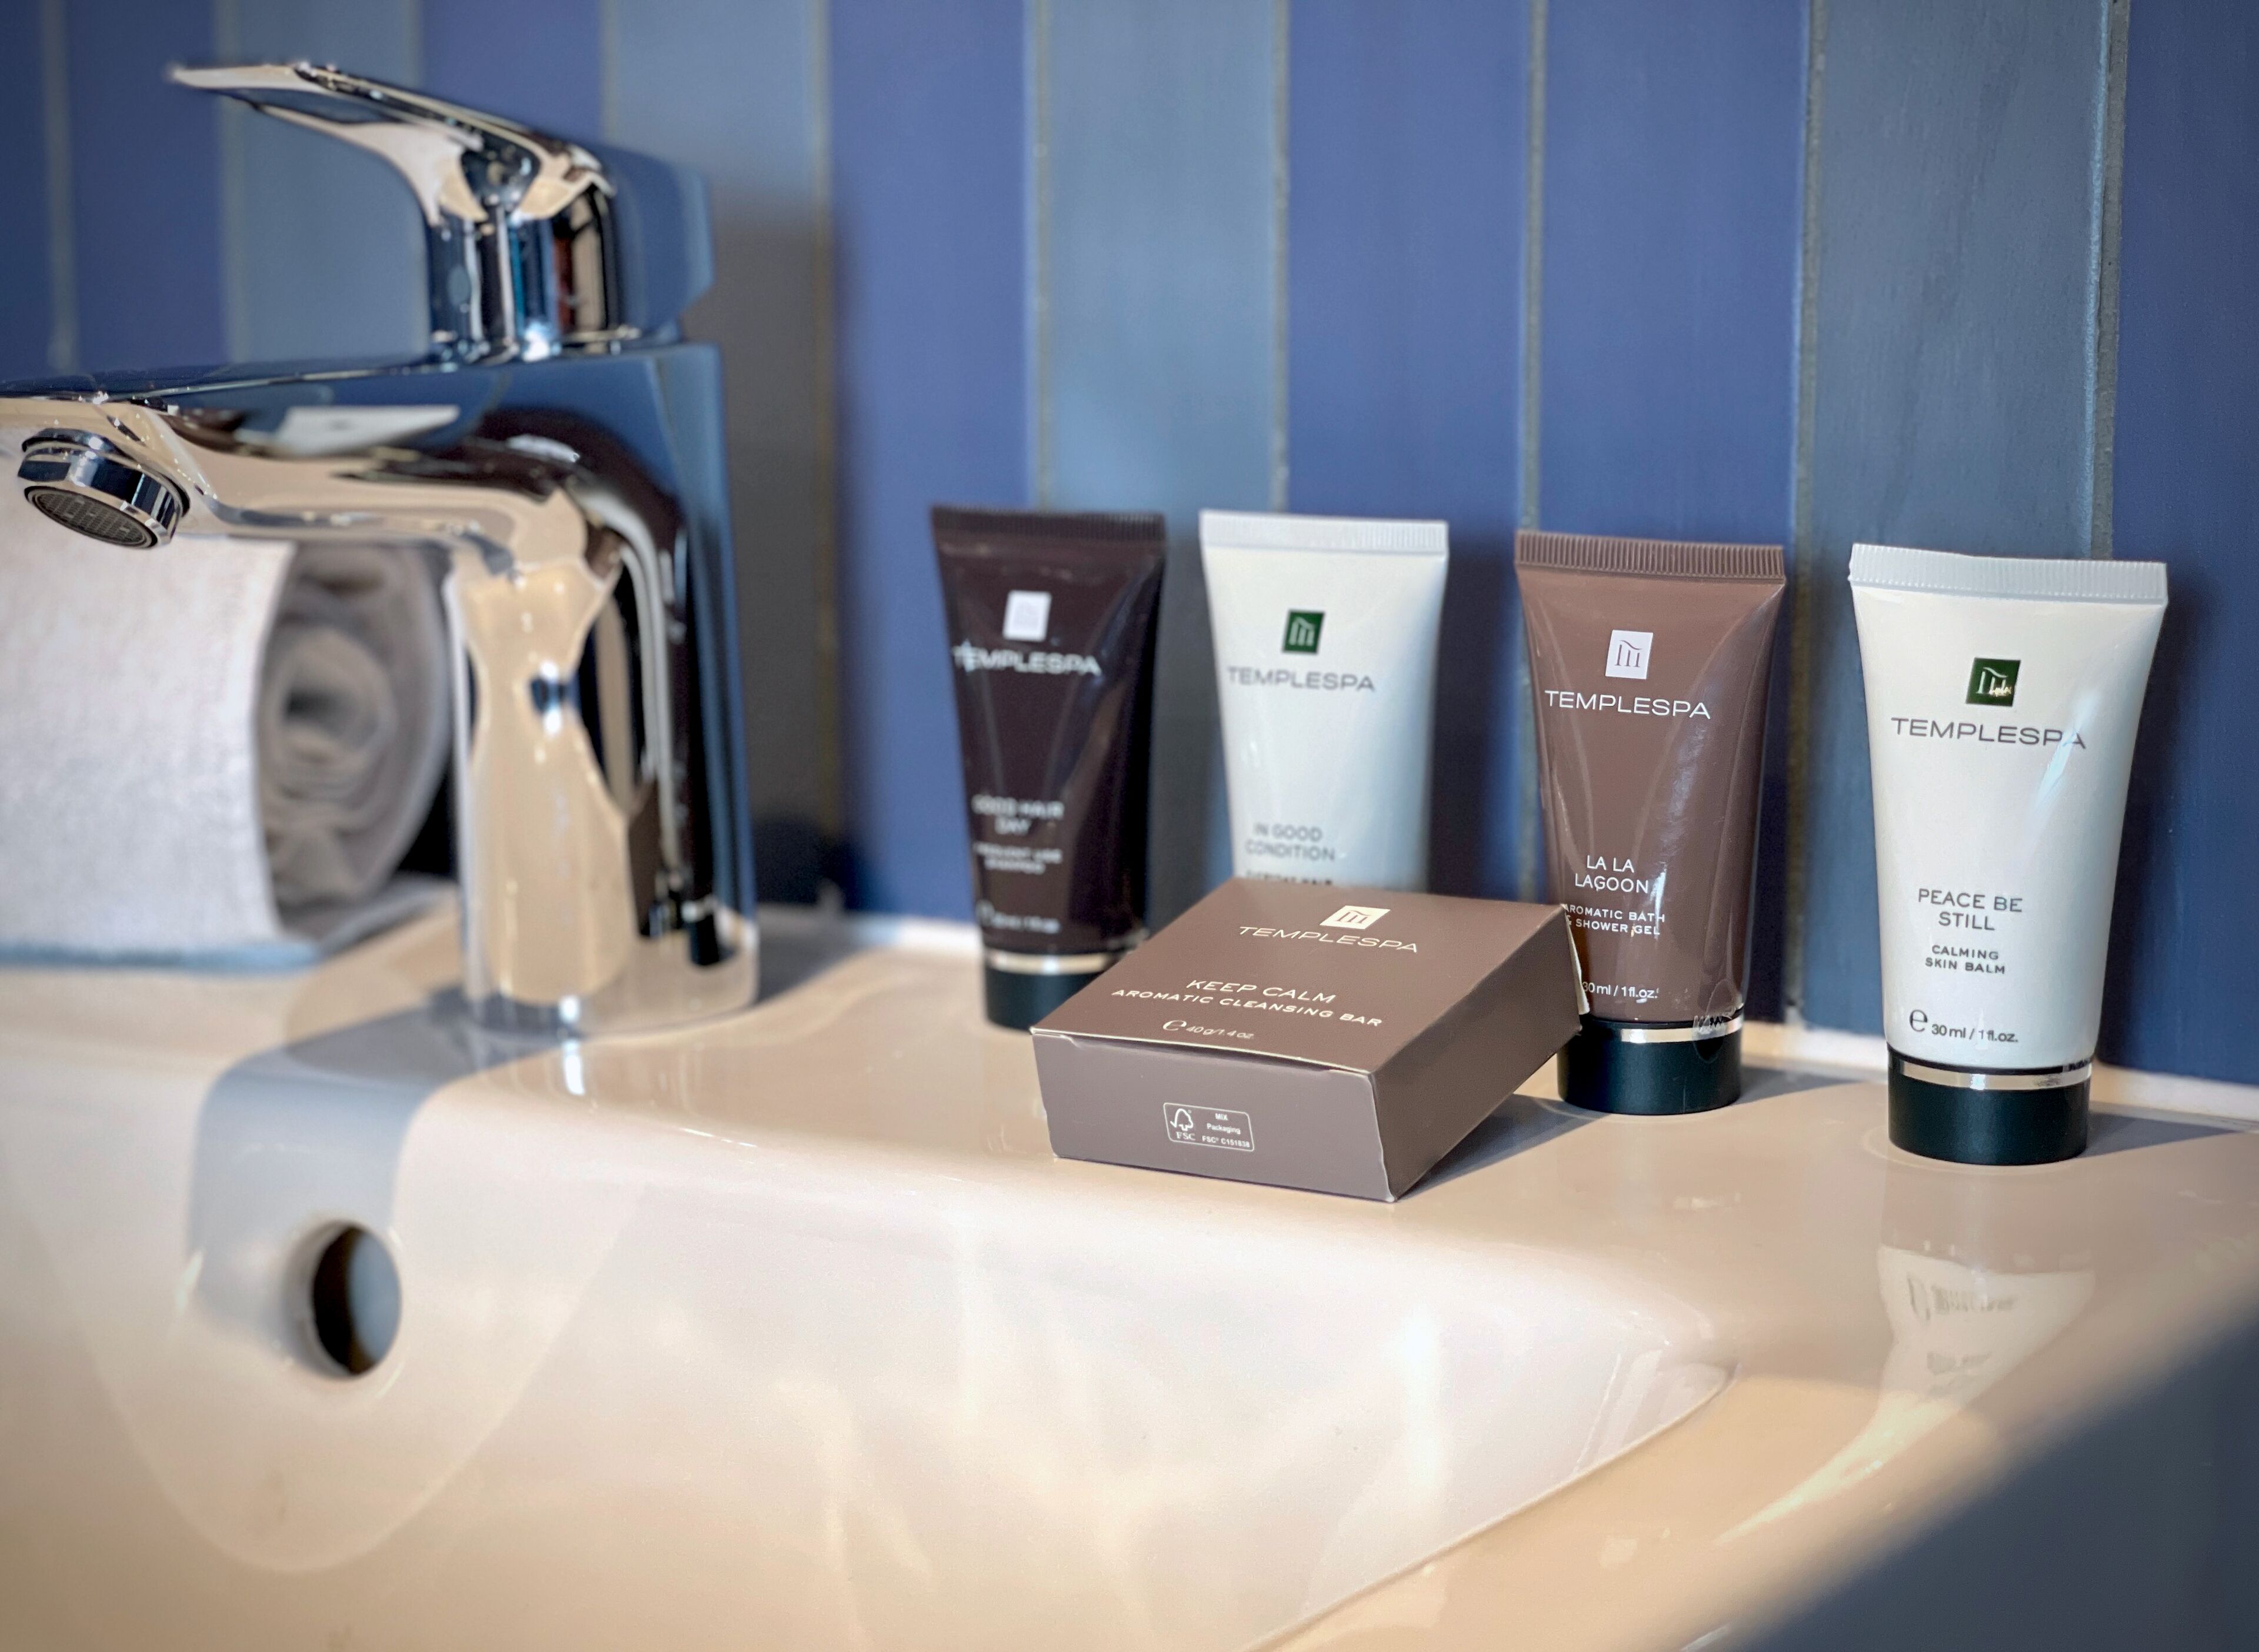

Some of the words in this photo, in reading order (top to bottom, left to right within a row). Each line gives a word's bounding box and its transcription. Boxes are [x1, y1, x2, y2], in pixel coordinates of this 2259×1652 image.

[952, 645, 1102, 676] TEMPLESPA
[1227, 665, 1375, 692] TEMPLESPA
[1544, 690, 1711, 720] TEMPLESPA
[1890, 716, 2087, 750] TEMPLESPA
[1272, 824, 1322, 842] GOOD
[1245, 838, 1335, 862] CONDITION
[1587, 855, 1607, 870] LA
[1612, 857, 1634, 873] LA
[1574, 873, 1649, 894] LAGOON
[1918, 887, 1985, 910] PEACE
[1994, 896, 2023, 913] BE
[1575, 919, 1628, 933] SHOWER
[1634, 925, 1660, 935] GEL
[1628, 912, 1665, 923] BATH
[1938, 911, 1995, 931] STILL
[1240, 926, 1418, 953] TEMPLESPA
[1931, 944, 1999, 960] CALMING
[1925, 956, 1957, 970] SKIN
[1965, 962, 2005, 974] BALM
[1186, 979, 1257, 994] KEEP
[1262, 986, 1337, 1004] CALM
[1111, 989, 1214, 1004] AROMATIC
[1219, 998, 1334, 1018] CLEANSING
[1340, 1013, 1382, 1027] BAR
[1215, 1113, 1228, 1121] MIX
[1176, 1131, 1196, 1141] FSC
[1207, 1123, 1241, 1135] Packaging
